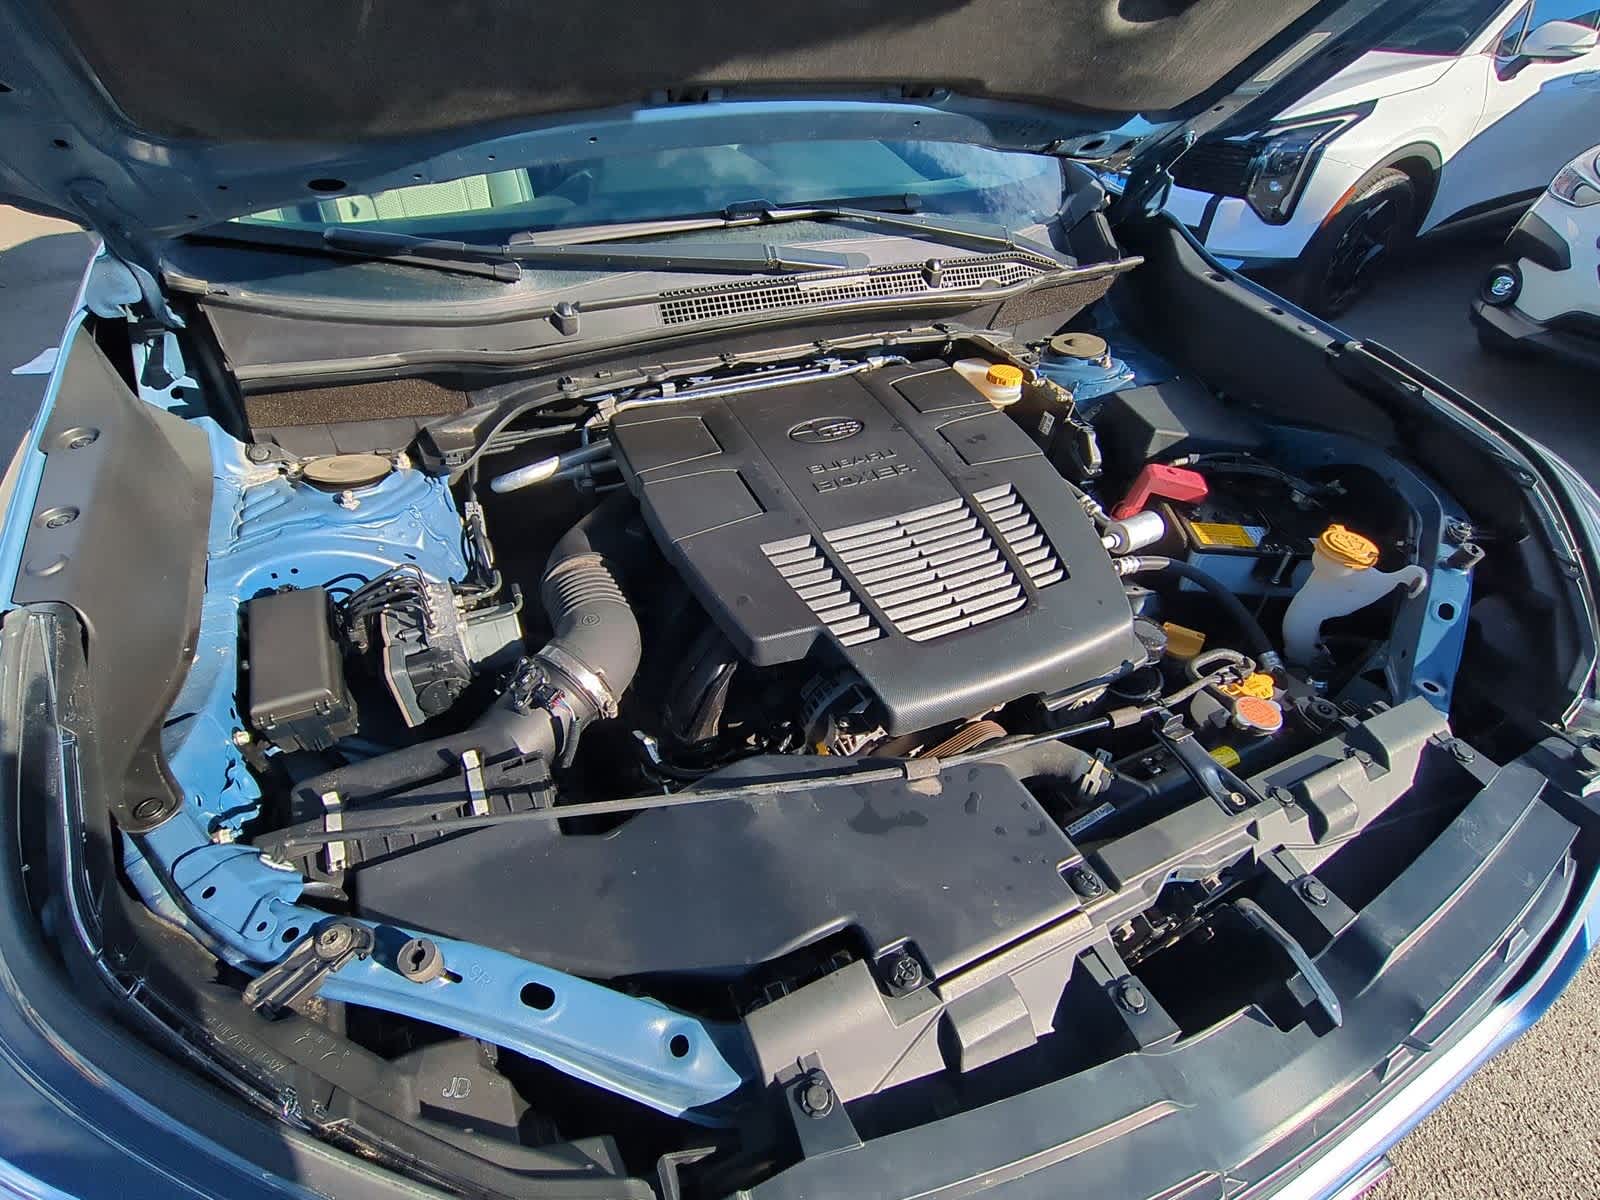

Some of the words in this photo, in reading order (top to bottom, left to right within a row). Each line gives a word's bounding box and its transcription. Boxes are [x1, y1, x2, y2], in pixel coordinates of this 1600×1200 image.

[806, 449, 897, 474] SUBARU
[812, 463, 918, 494] BOXER
[442, 1076, 471, 1099] JD
